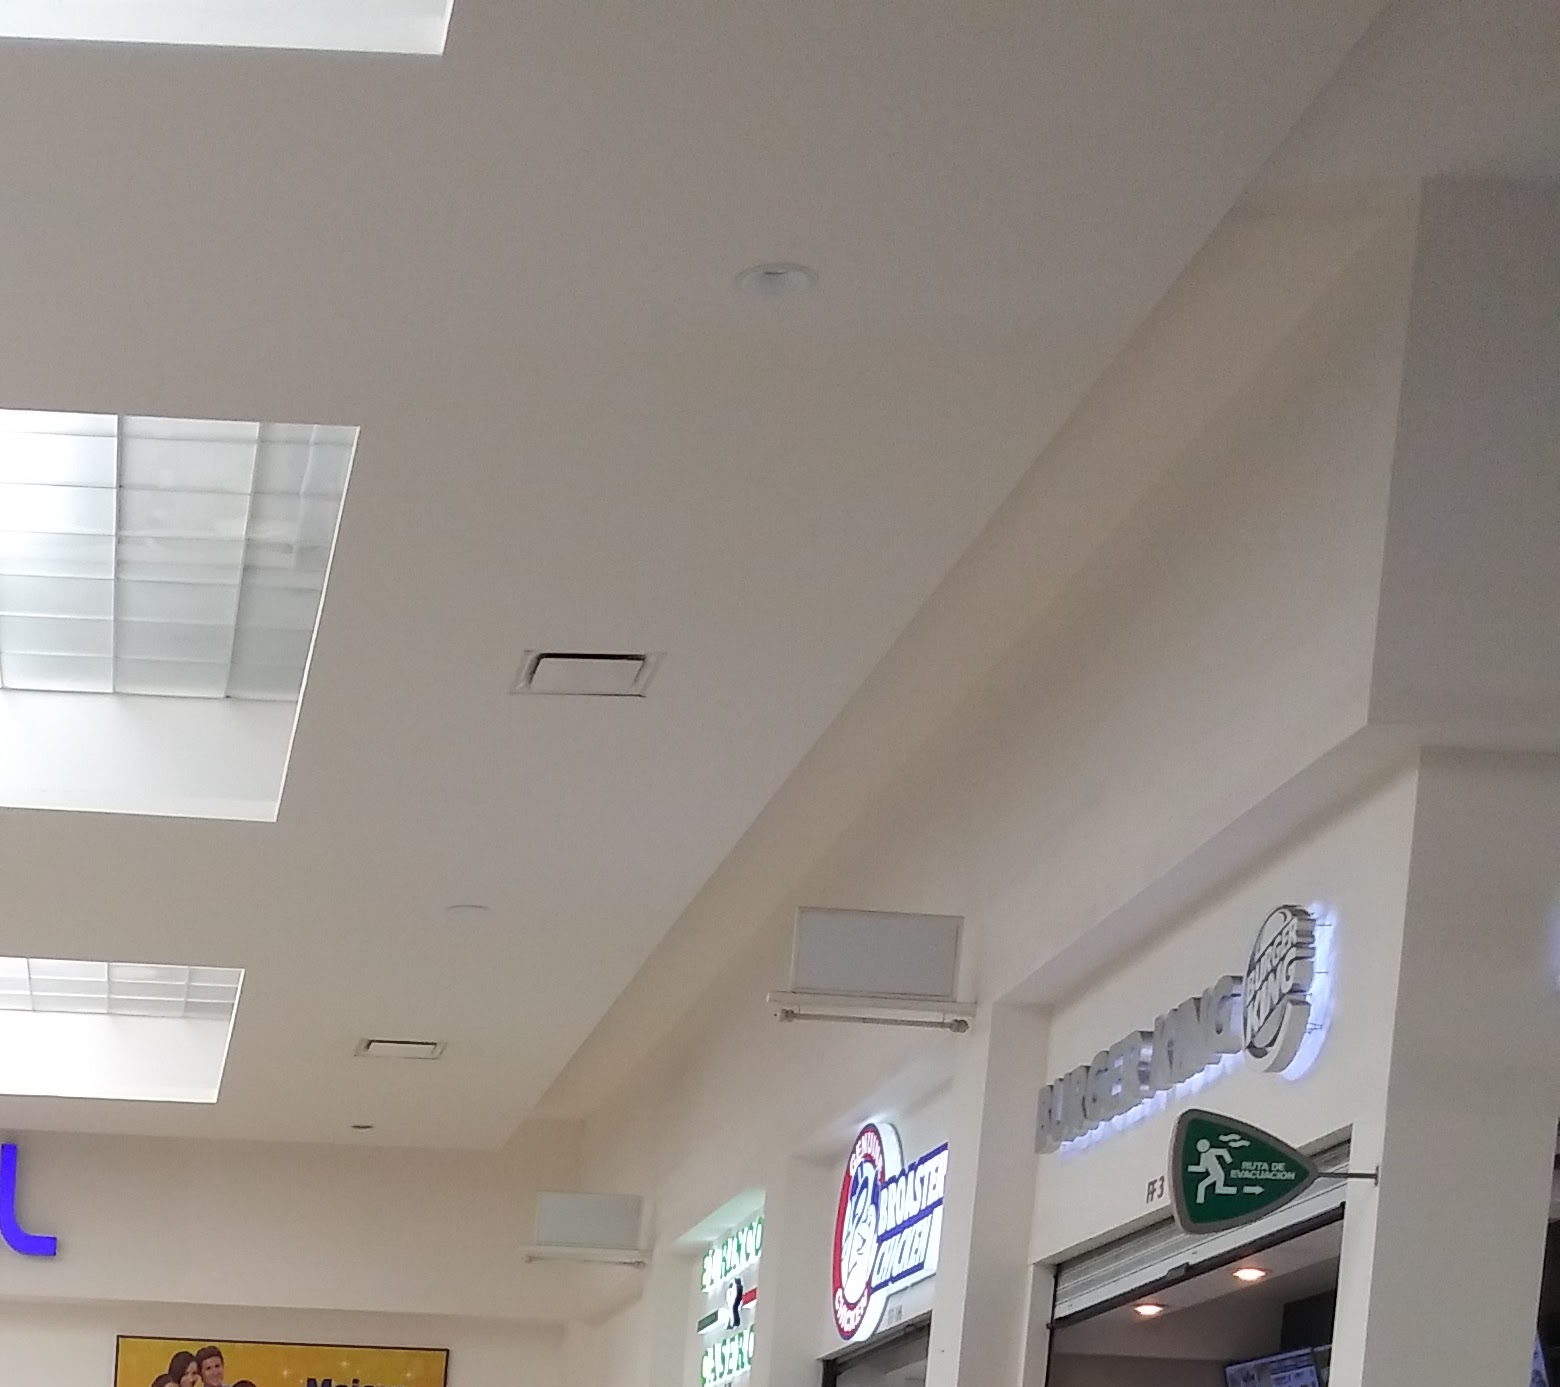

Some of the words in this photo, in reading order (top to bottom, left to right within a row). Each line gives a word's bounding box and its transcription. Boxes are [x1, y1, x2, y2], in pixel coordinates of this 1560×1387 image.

[1241, 1162, 1269, 1171] RUTA
[1271, 1163, 1286, 1171] DE
[878, 1150, 947, 1232] BROASTER
